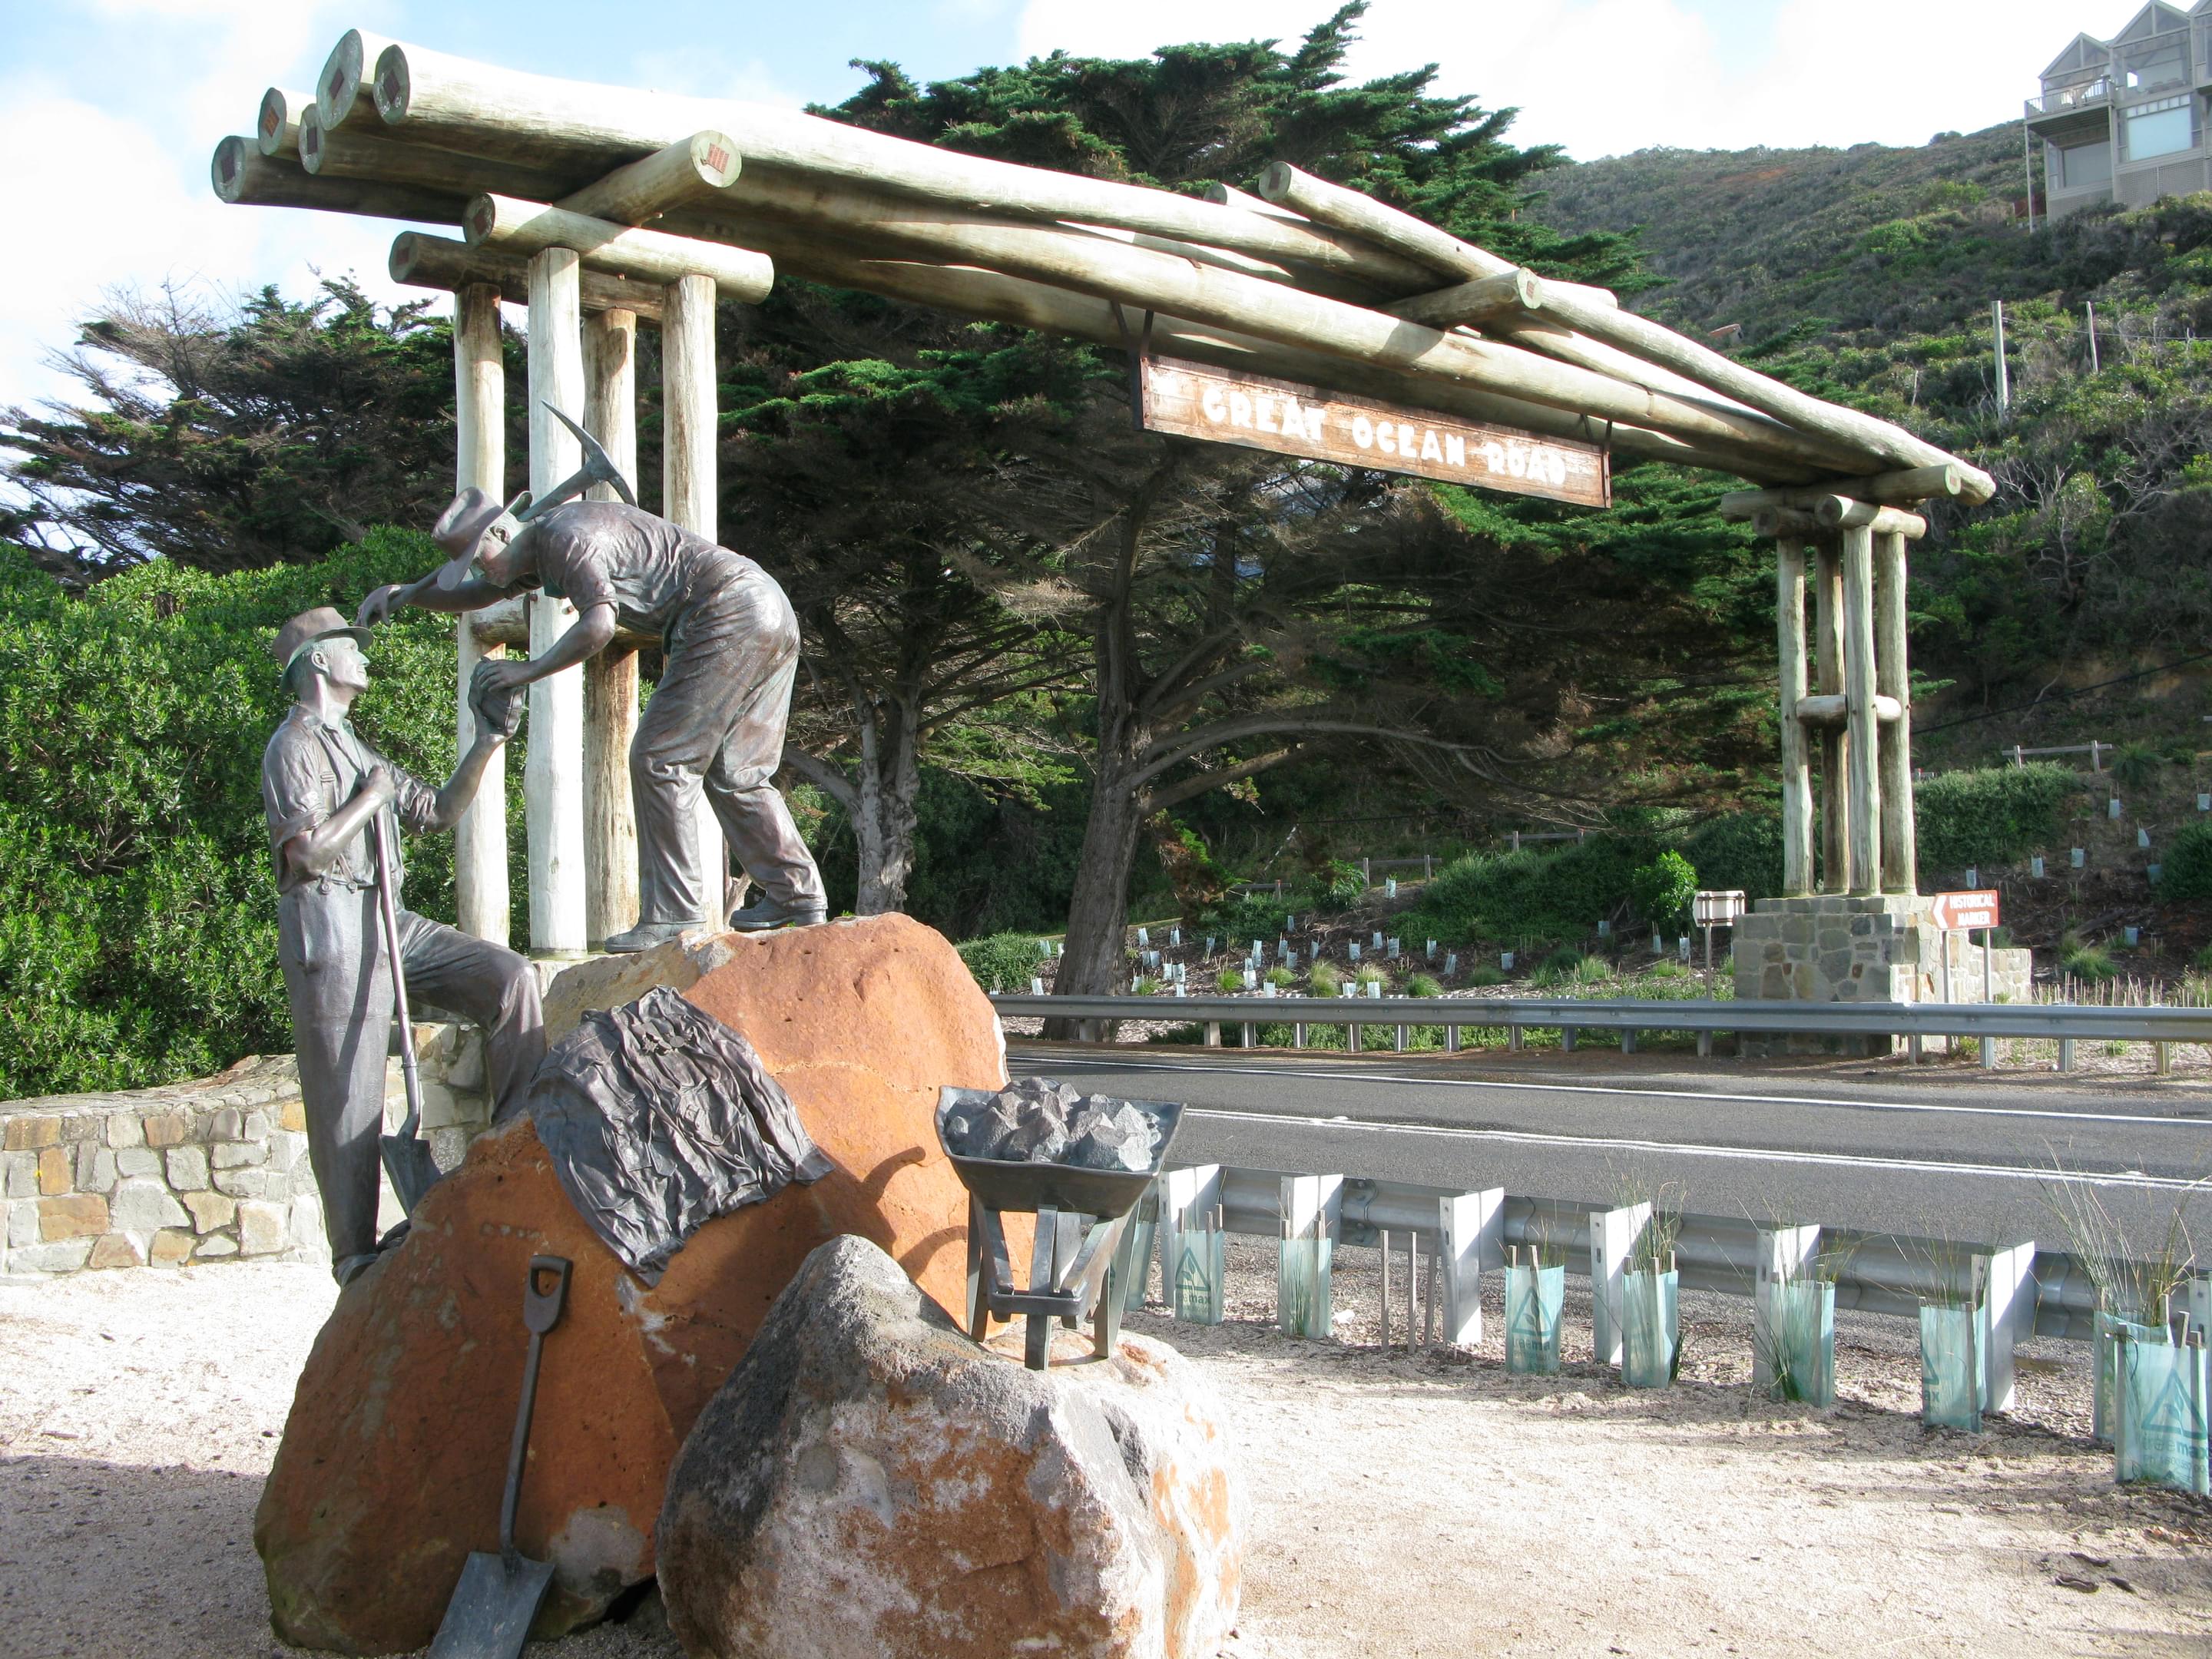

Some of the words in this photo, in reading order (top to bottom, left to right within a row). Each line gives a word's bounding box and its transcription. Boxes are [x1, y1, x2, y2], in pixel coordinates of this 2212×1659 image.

[1202, 386, 1327, 441] GREAT
[1352, 417, 1465, 467] OCEAN
[1486, 441, 1567, 485] ROAD
[1949, 893, 1995, 909] HISTORICAL
[1958, 911, 1991, 926] MARKER
